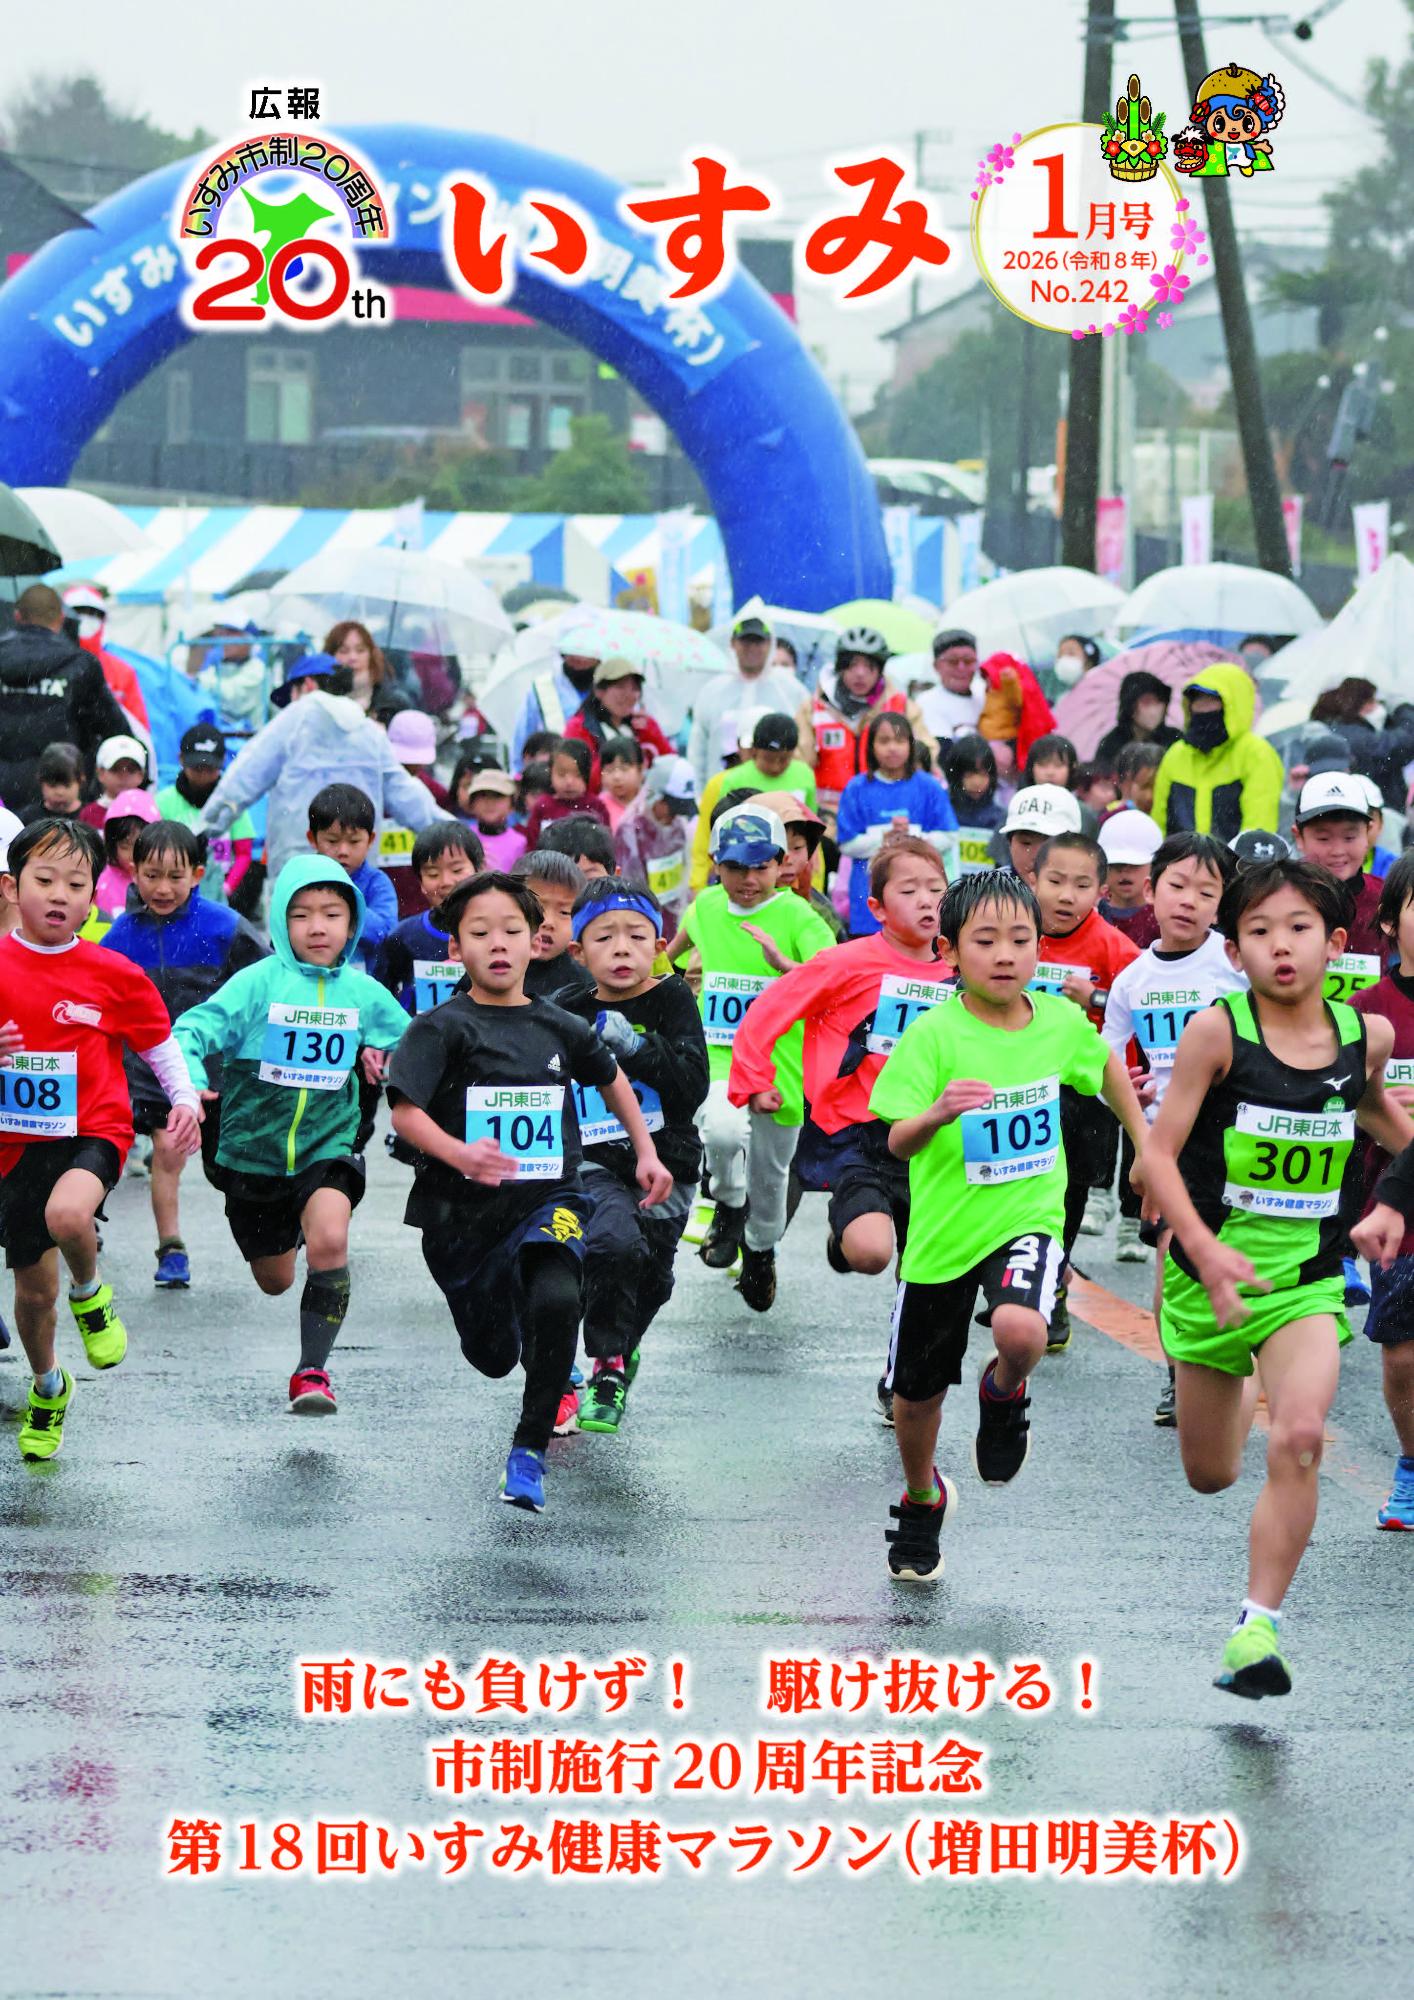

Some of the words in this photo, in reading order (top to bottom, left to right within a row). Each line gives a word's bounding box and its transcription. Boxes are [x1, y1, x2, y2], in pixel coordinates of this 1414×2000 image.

[54, 244, 178, 347] いすみ
[1018, 798, 1052, 815] GAP
[709, 975, 764, 991] JR東日本
[896, 983, 957, 1001] JR東日
[1140, 989, 1201, 1006] JR東日本
[284, 1010, 348, 1026] JR東日本
[283, 1030, 345, 1065] 130
[283, 1071, 343, 1083] いすみ健康マラソン
[1386, 1065, 1414, 1079] JR
[0, 1074, 61, 1110] 108
[484, 1091, 552, 1107] JR東日本
[486, 1114, 554, 1151] 104
[982, 1108, 1052, 1154] 103
[1257, 1115, 1342, 1137] JR東日本
[993, 1156, 1056, 1176] いすみ健康マラソン
[1248, 1141, 1335, 1186] 301
[1255, 1195, 1333, 1210] いすみ健康マラソン
[1001, 1234, 1040, 1290] FILA
